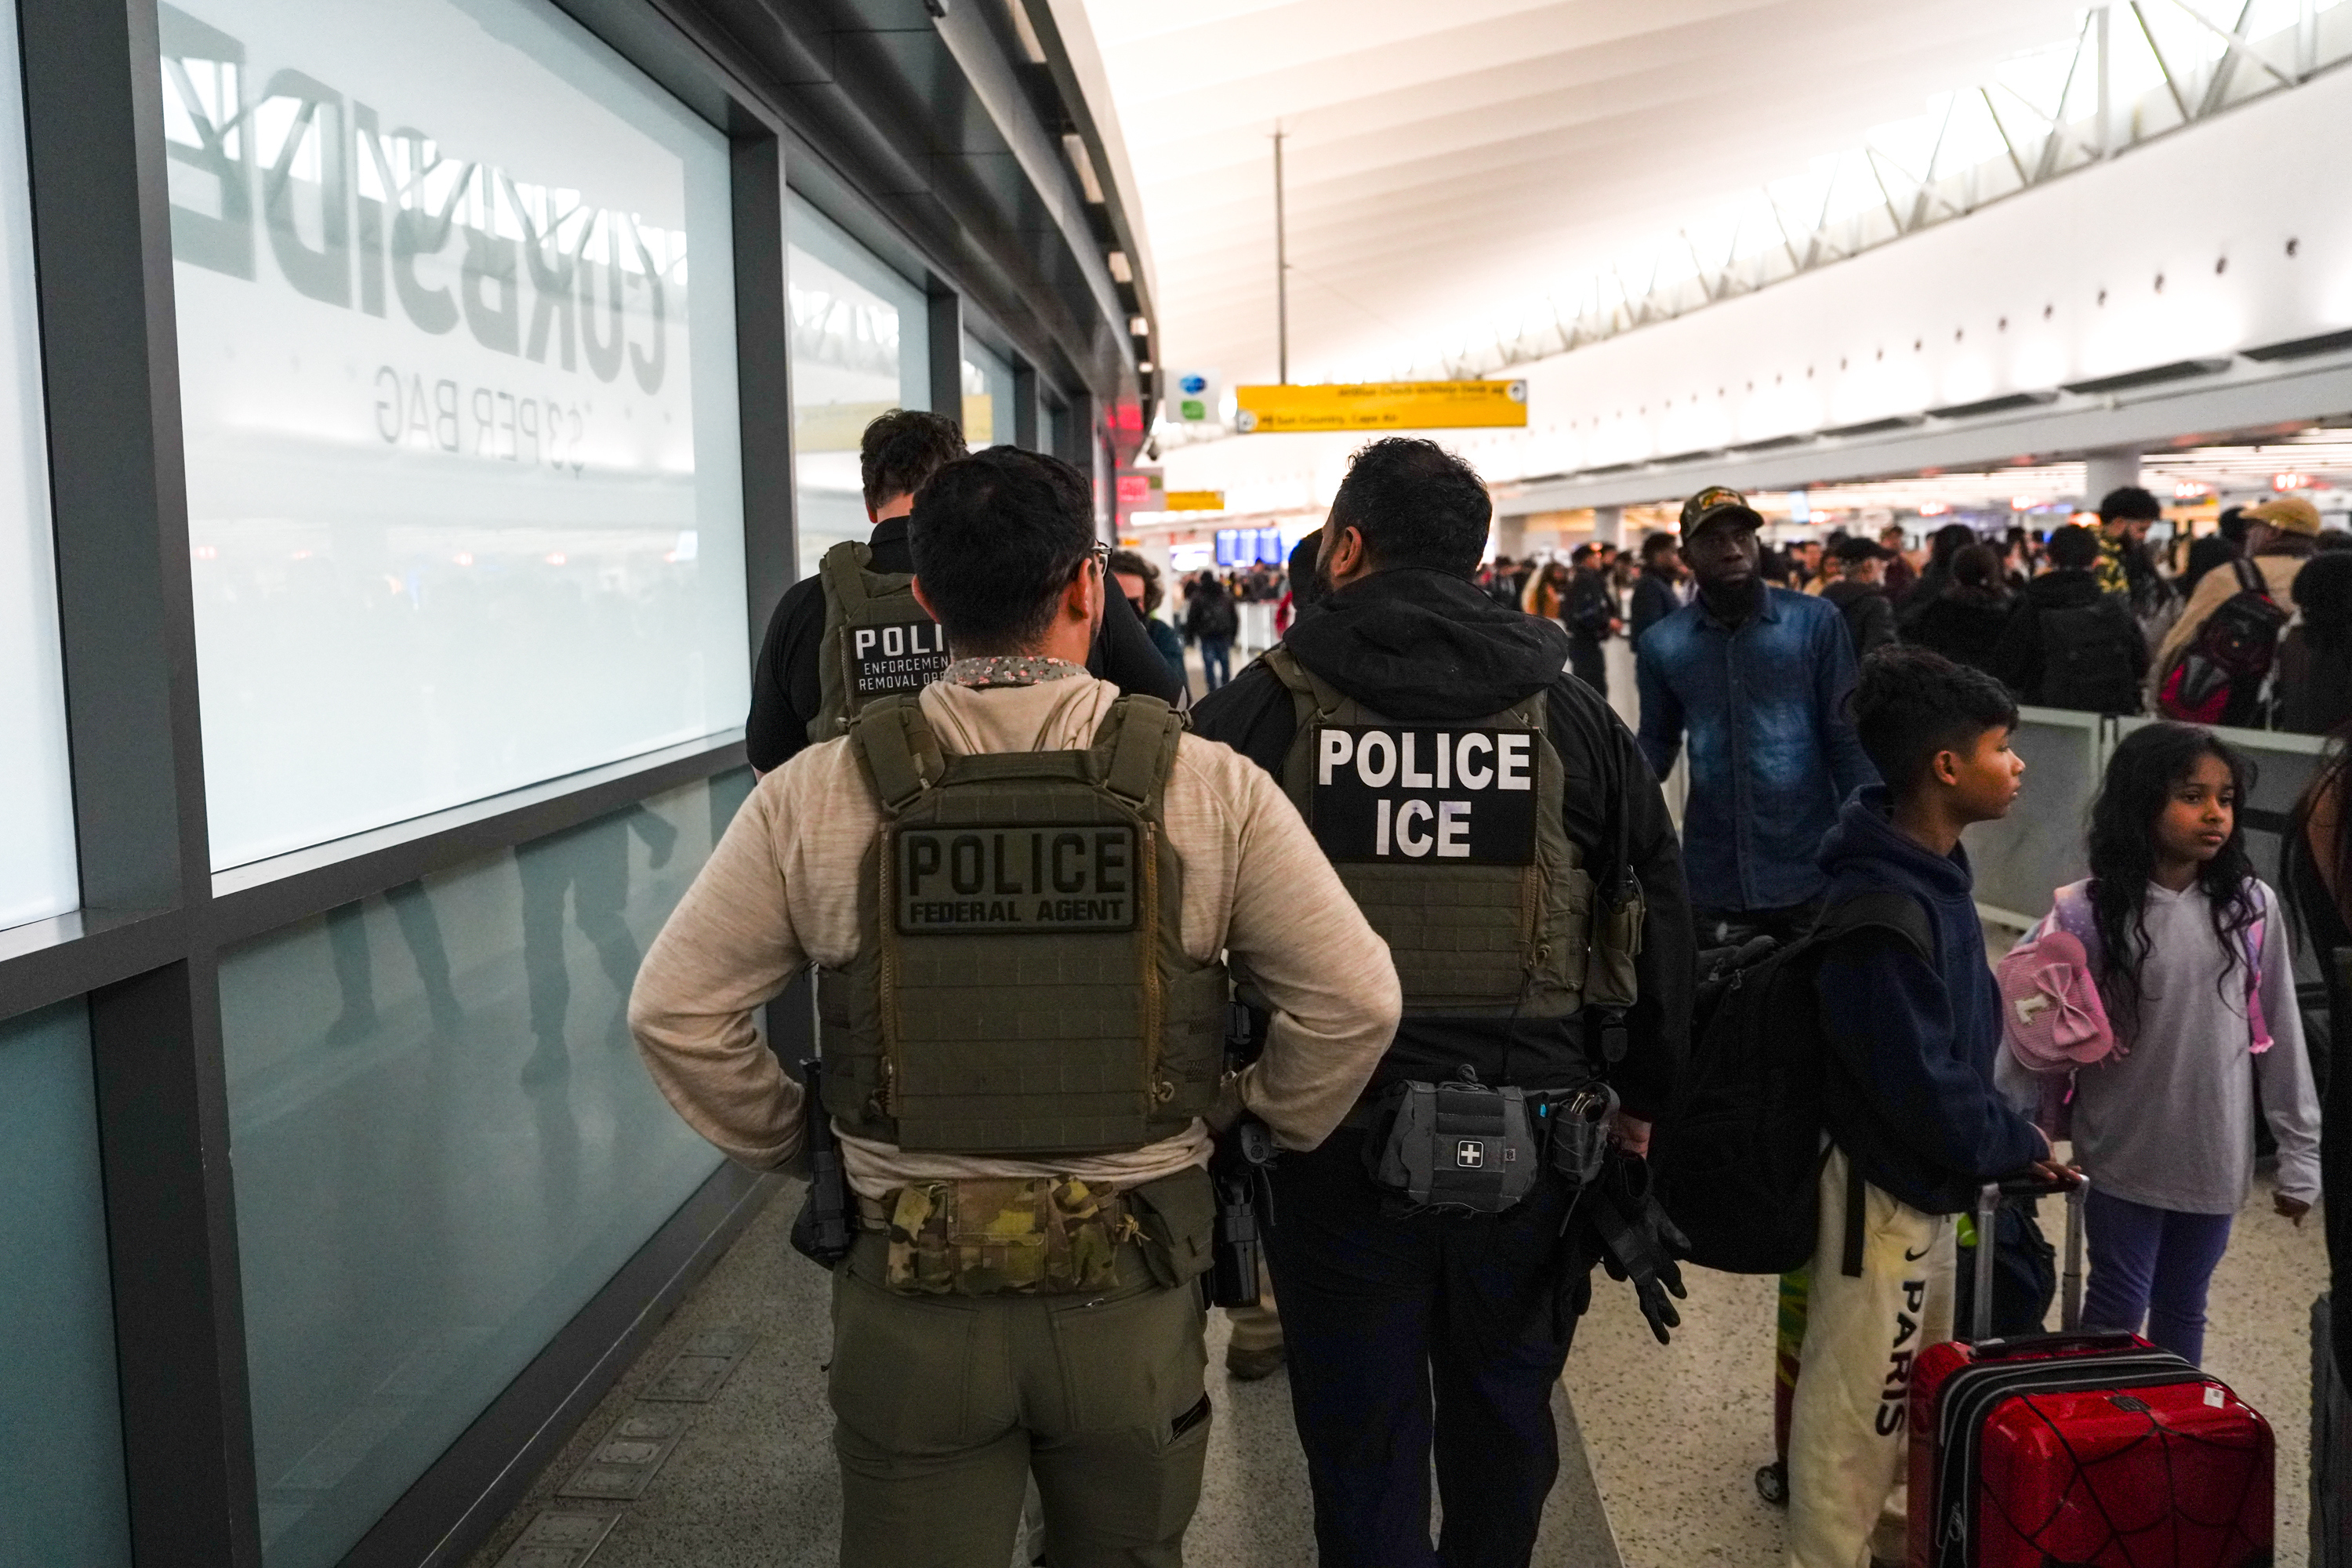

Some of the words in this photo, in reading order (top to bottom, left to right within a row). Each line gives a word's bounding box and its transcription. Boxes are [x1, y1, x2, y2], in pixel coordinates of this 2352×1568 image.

[858, 673, 917, 691] REMOVAL
[1319, 729, 1530, 790] POLICE
[1377, 799, 1472, 858] ICE
[908, 833, 1125, 896] POLICE
[910, 901, 1022, 924] FEDERAL
[1036, 899, 1123, 922] AGENT
[1875, 1280, 1926, 1436] PARIS
